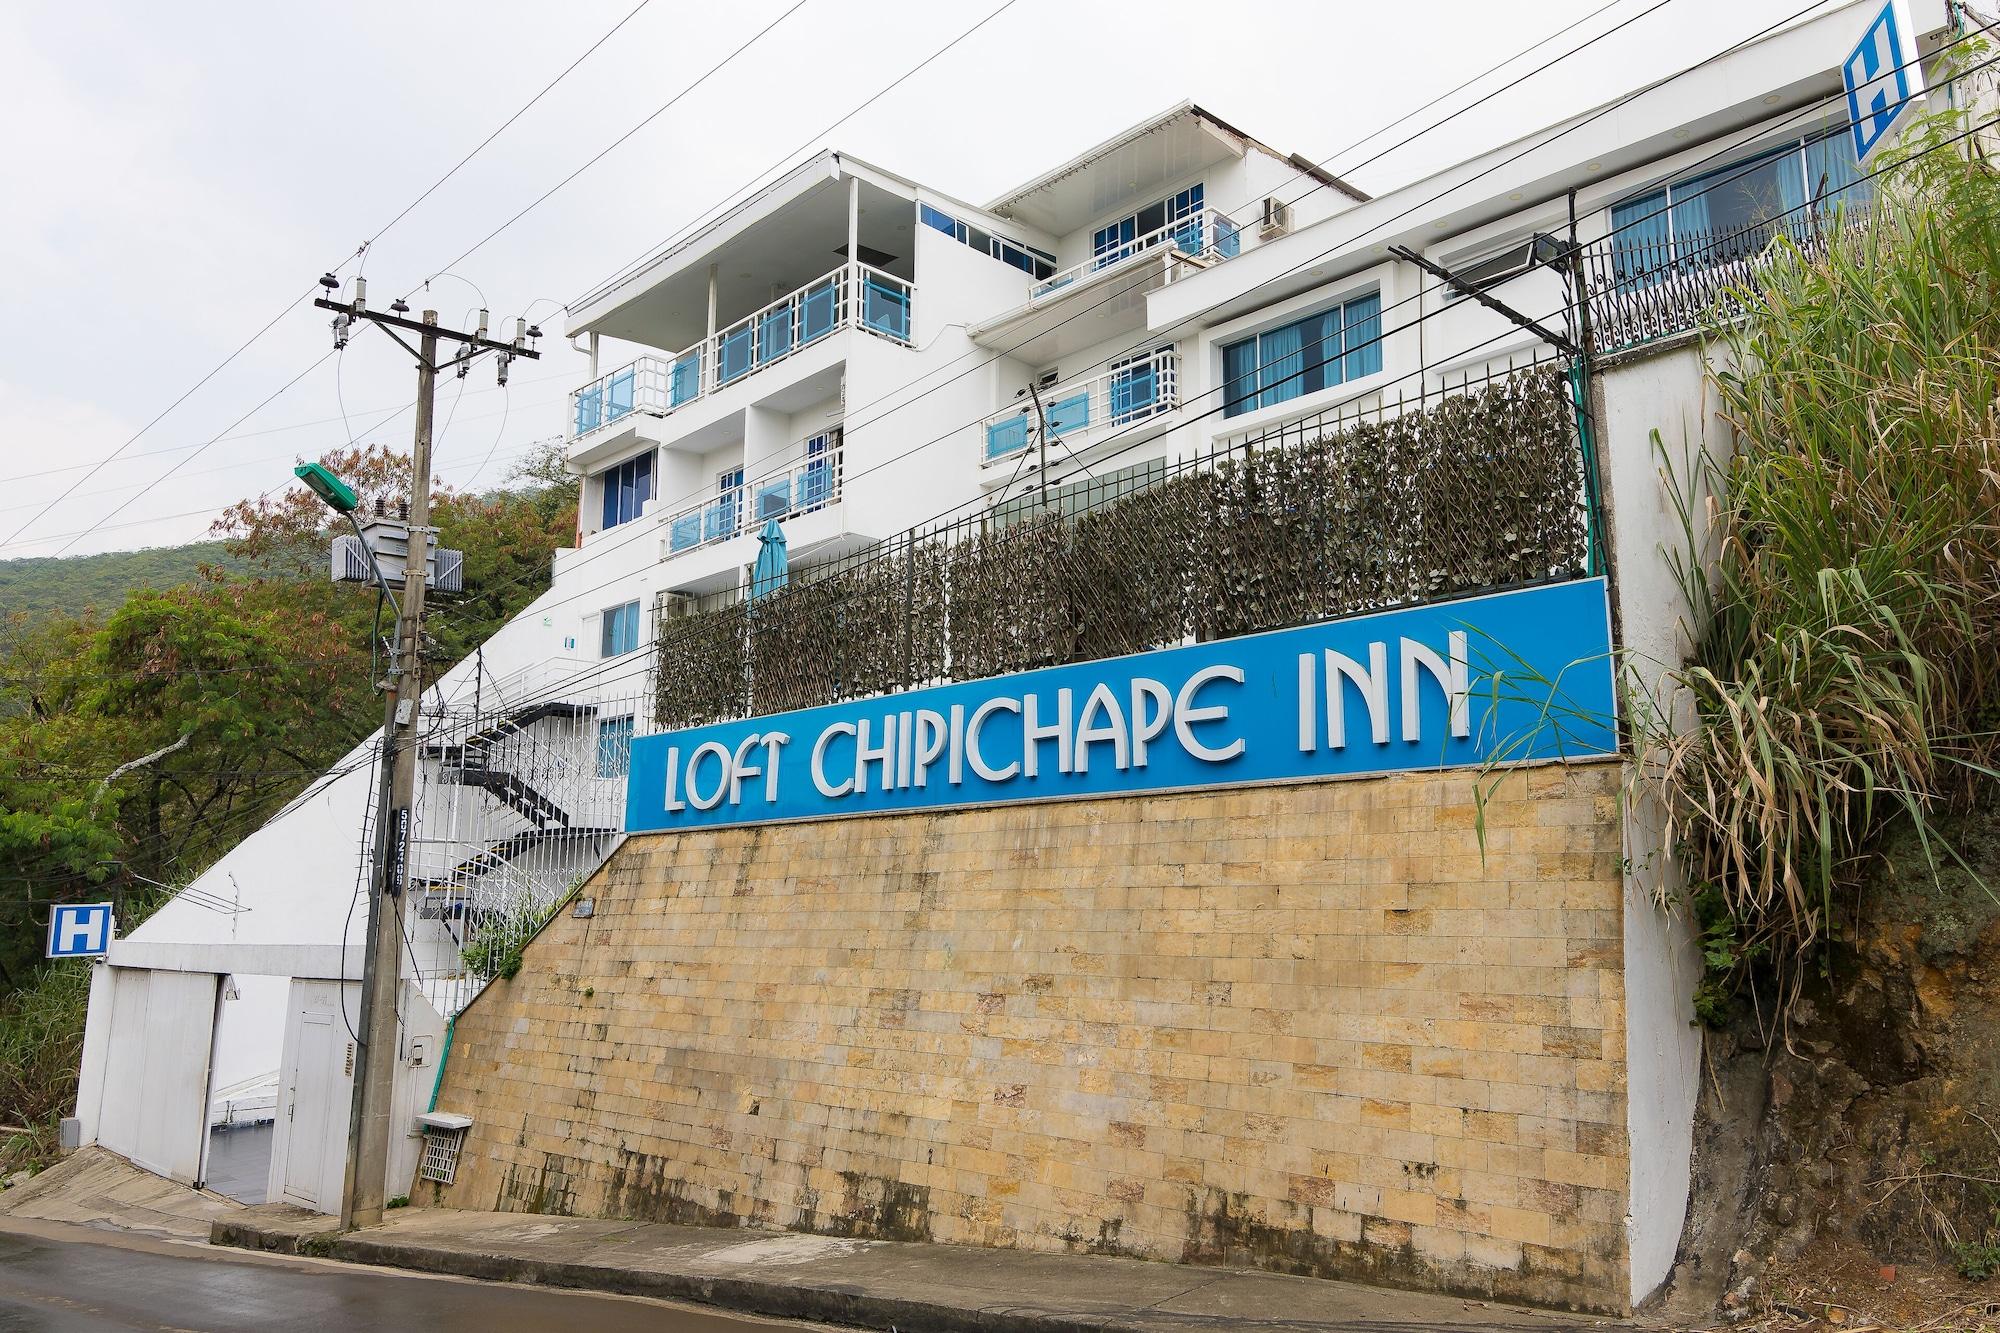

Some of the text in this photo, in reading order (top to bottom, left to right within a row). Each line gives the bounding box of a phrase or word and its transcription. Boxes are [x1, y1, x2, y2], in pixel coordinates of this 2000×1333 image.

[1851, 18, 1900, 146] H
[664, 630, 1470, 812] LOFT CHIPICHAPE INN
[59, 909, 104, 951] H
